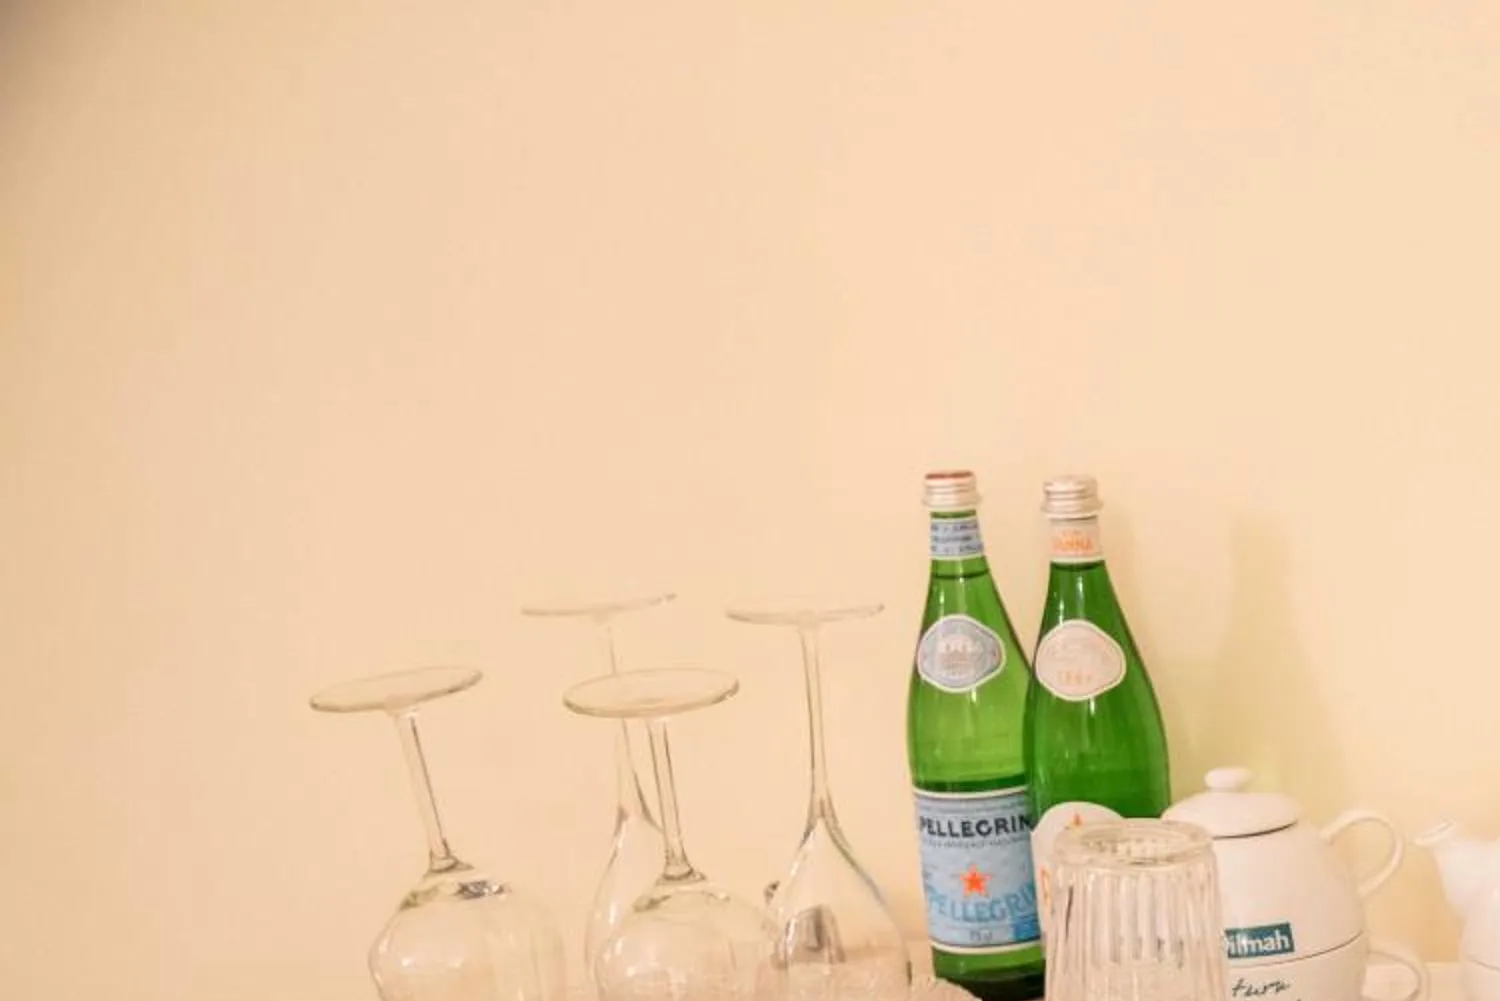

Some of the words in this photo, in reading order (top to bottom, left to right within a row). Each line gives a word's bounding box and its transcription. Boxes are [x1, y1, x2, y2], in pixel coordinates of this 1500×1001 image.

[920, 815, 1034, 838] PELLEGRIN
[926, 883, 1035, 923] PELLEGRI
[1227, 929, 1291, 956] ilmah
[1231, 978, 1291, 997] turn
